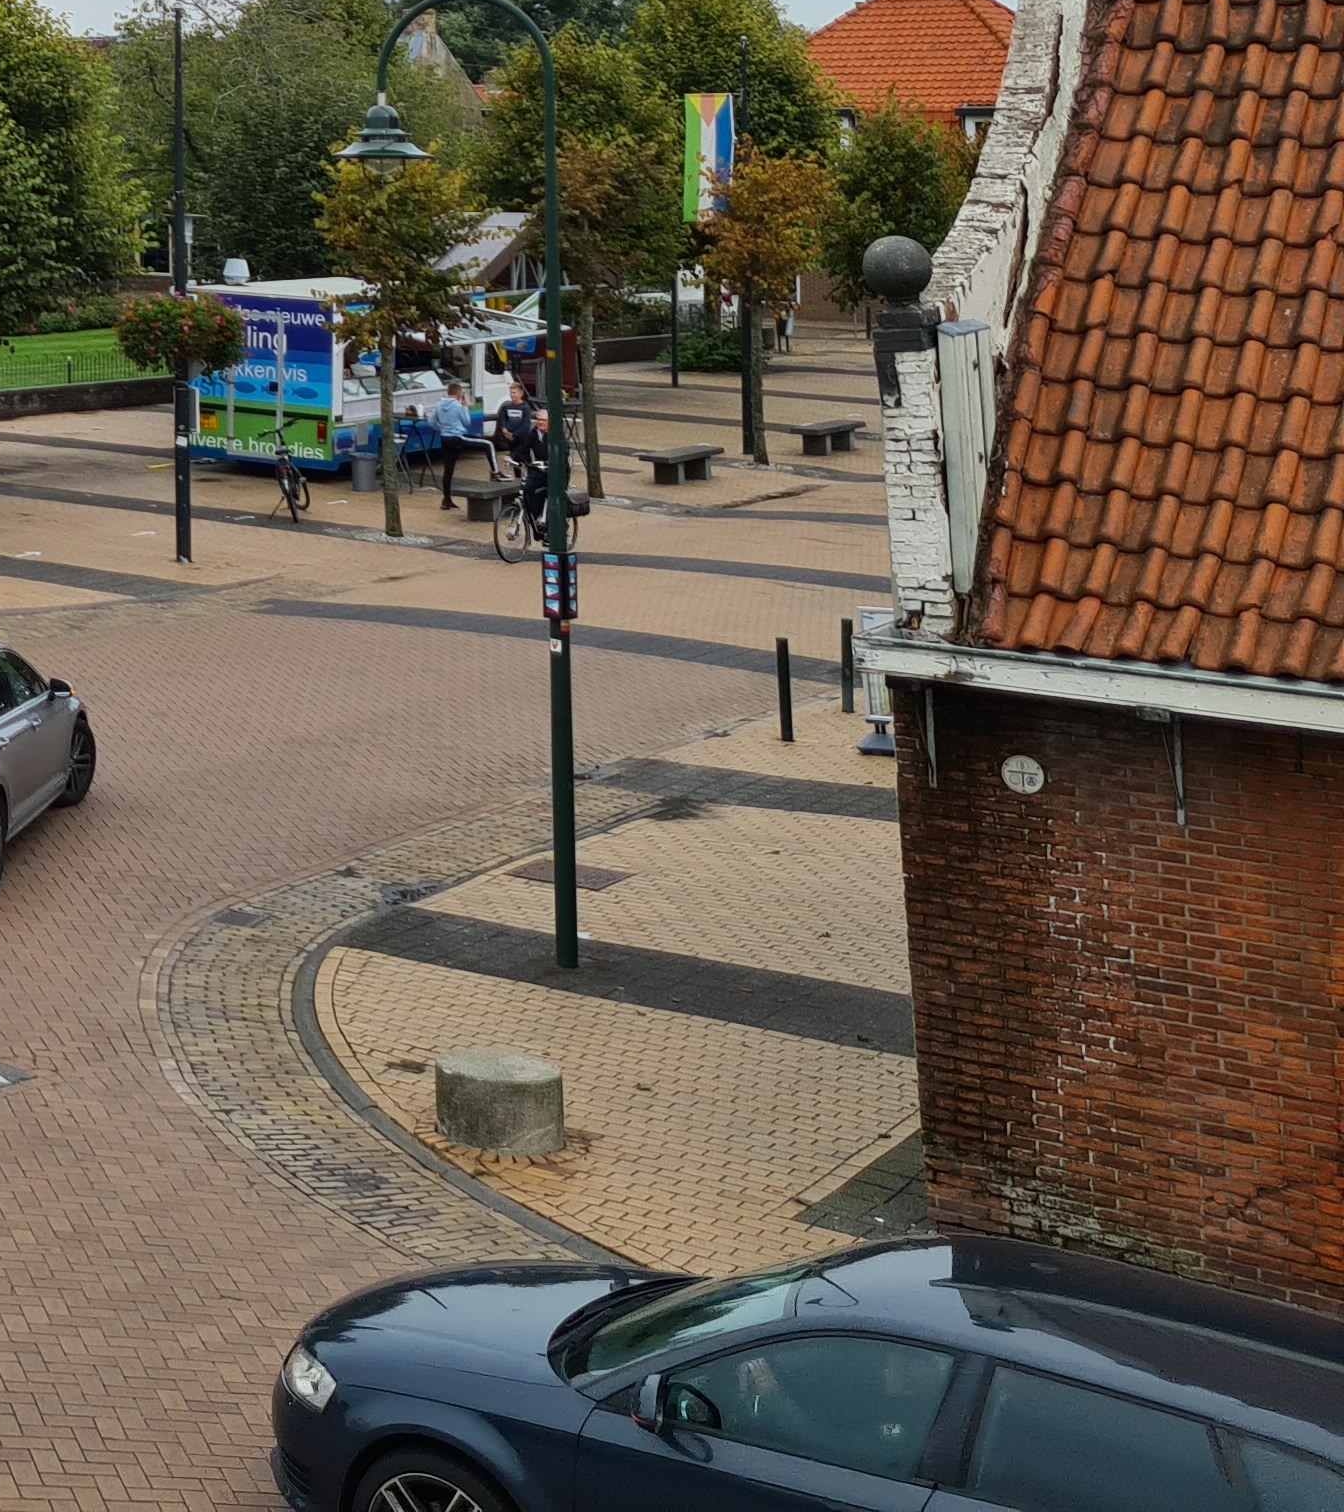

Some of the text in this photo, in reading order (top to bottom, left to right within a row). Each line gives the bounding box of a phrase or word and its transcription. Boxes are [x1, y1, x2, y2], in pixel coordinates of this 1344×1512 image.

[265, 306, 327, 327] nieuwe
[246, 325, 288, 356] ling
[282, 363, 308, 383] vis
